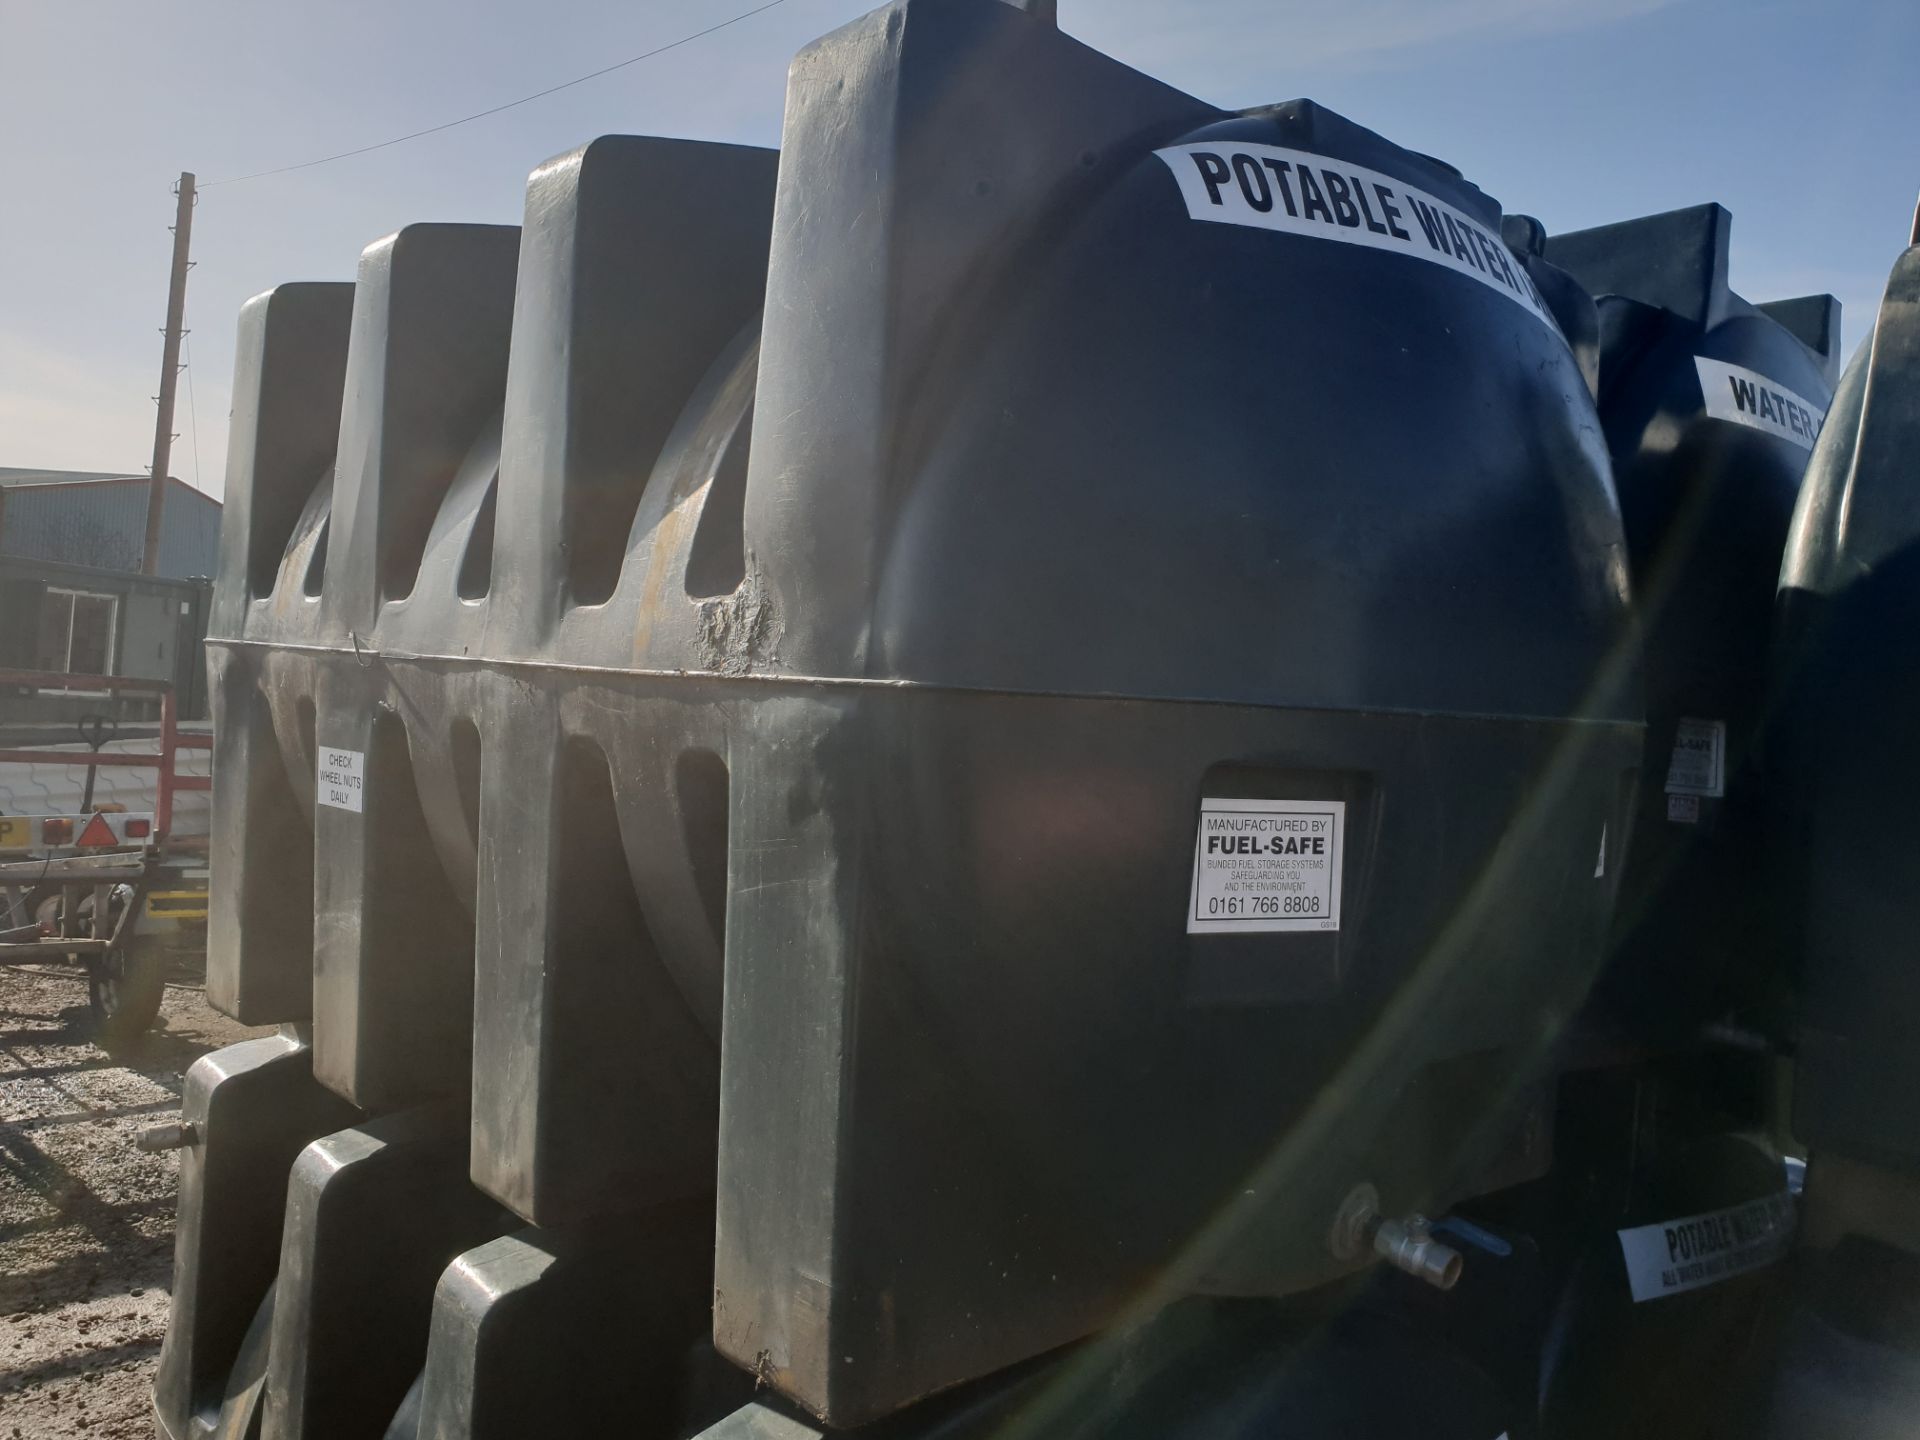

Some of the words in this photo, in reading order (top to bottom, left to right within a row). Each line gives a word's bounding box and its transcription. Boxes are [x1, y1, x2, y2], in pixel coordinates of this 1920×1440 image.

[1189, 151, 1412, 242] POTABLE
[1406, 194, 1523, 296] WATER
[1728, 375, 1816, 441] WATER
[328, 753, 352, 769] CHECK
[320, 769, 342, 786] WHEEL
[343, 774, 361, 790] NUTS
[330, 790, 349, 804] DAILY
[1207, 818, 1308, 832] MANUFACTURED
[1311, 820, 1328, 832] BY
[1207, 835, 1325, 855] FUEL-SAFE
[1207, 859, 1237, 869] BUNDED
[1238, 860, 1254, 869] FUEL
[1257, 860, 1290, 869] STORAGE
[1291, 860, 1324, 869] SYSTEMS
[1230, 870, 1285, 880] SAFEGUARDING
[1286, 871, 1300, 880] YOU
[1224, 882, 1239, 891] AND
[1241, 882, 1254, 891] THE
[1256, 882, 1306, 892] ENVIRONMENT
[1208, 896, 1245, 914] 0161
[1251, 896, 1279, 913] 766
[1283, 896, 1320, 913] 8808
[1664, 1215, 1732, 1263] POTABLE
